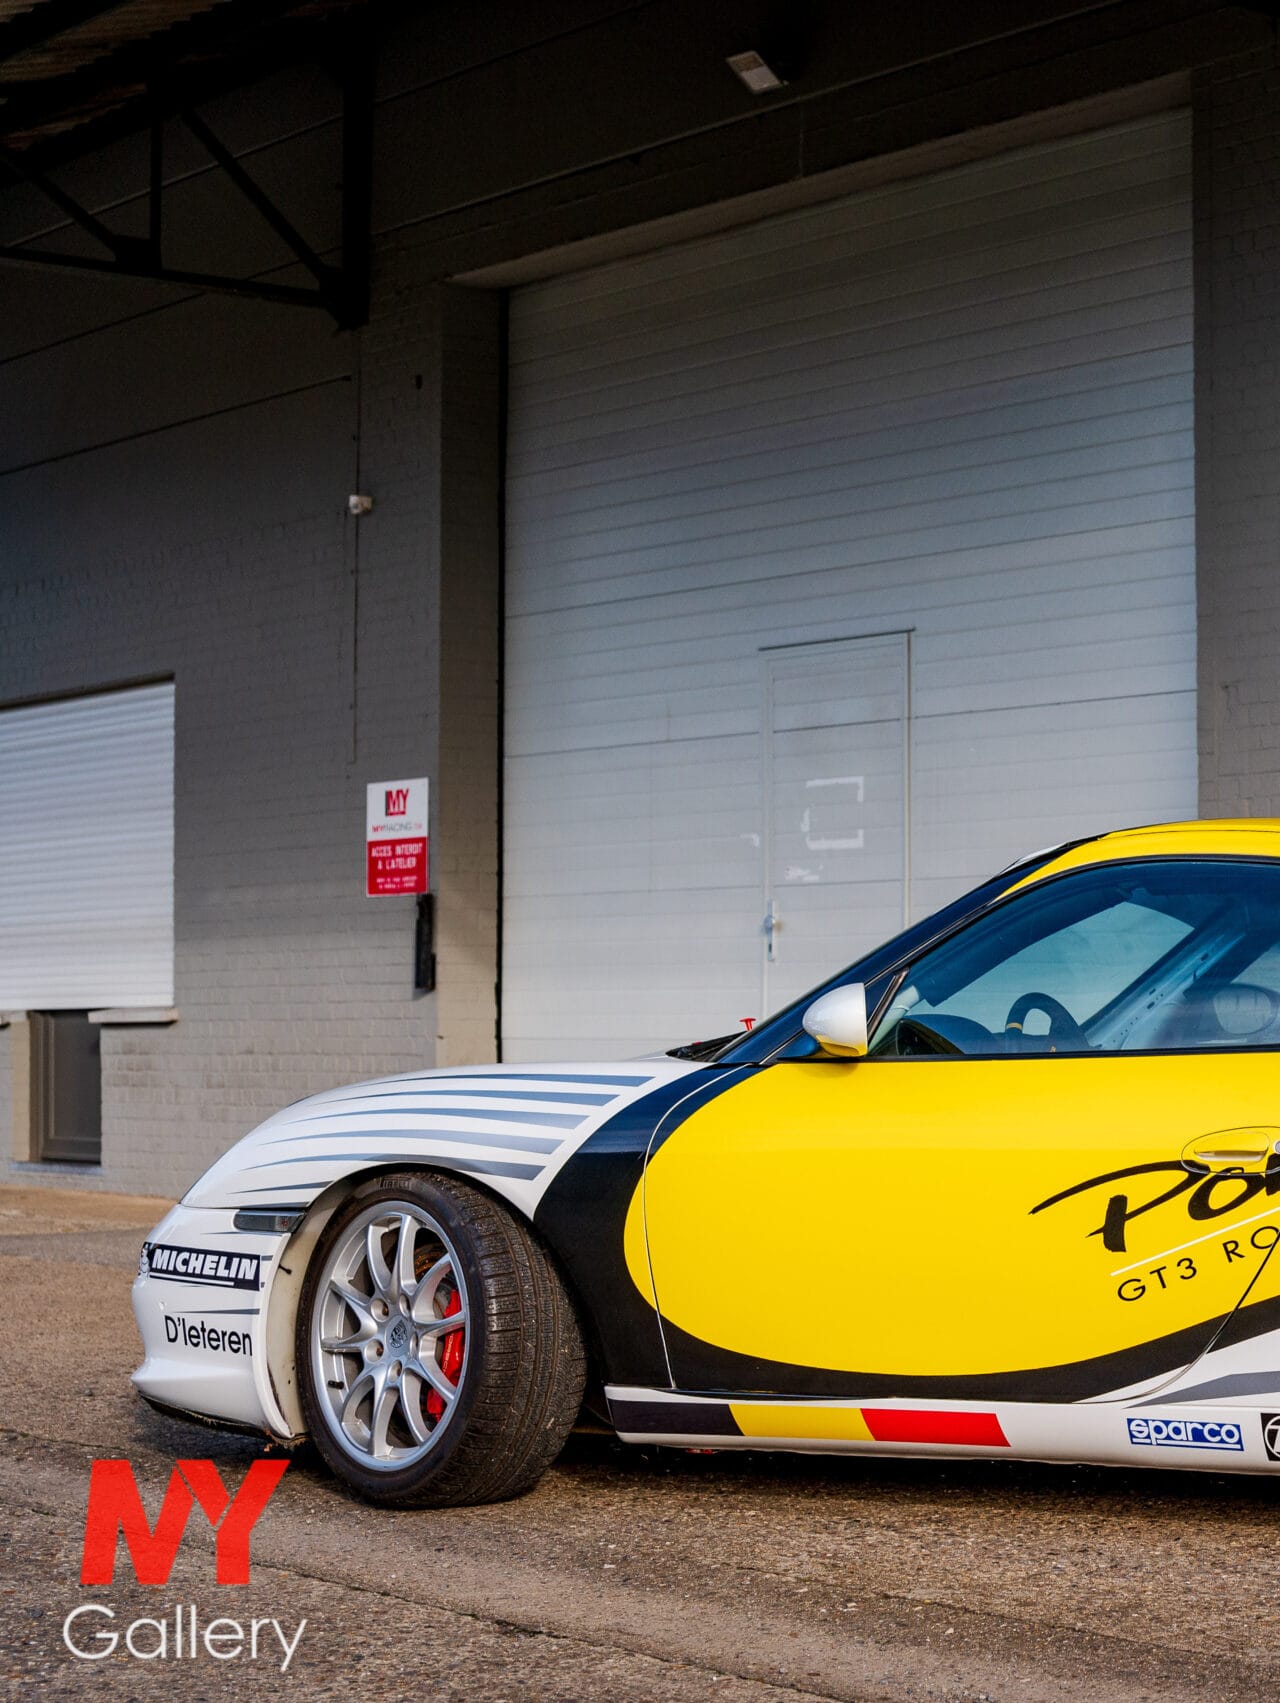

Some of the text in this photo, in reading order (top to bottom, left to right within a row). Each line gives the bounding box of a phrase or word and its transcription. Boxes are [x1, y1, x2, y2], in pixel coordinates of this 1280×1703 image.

[151, 1248, 258, 1281] MICHELIN
[1117, 1258, 1198, 1301] GT3
[1130, 1419, 1240, 1445] sparco
